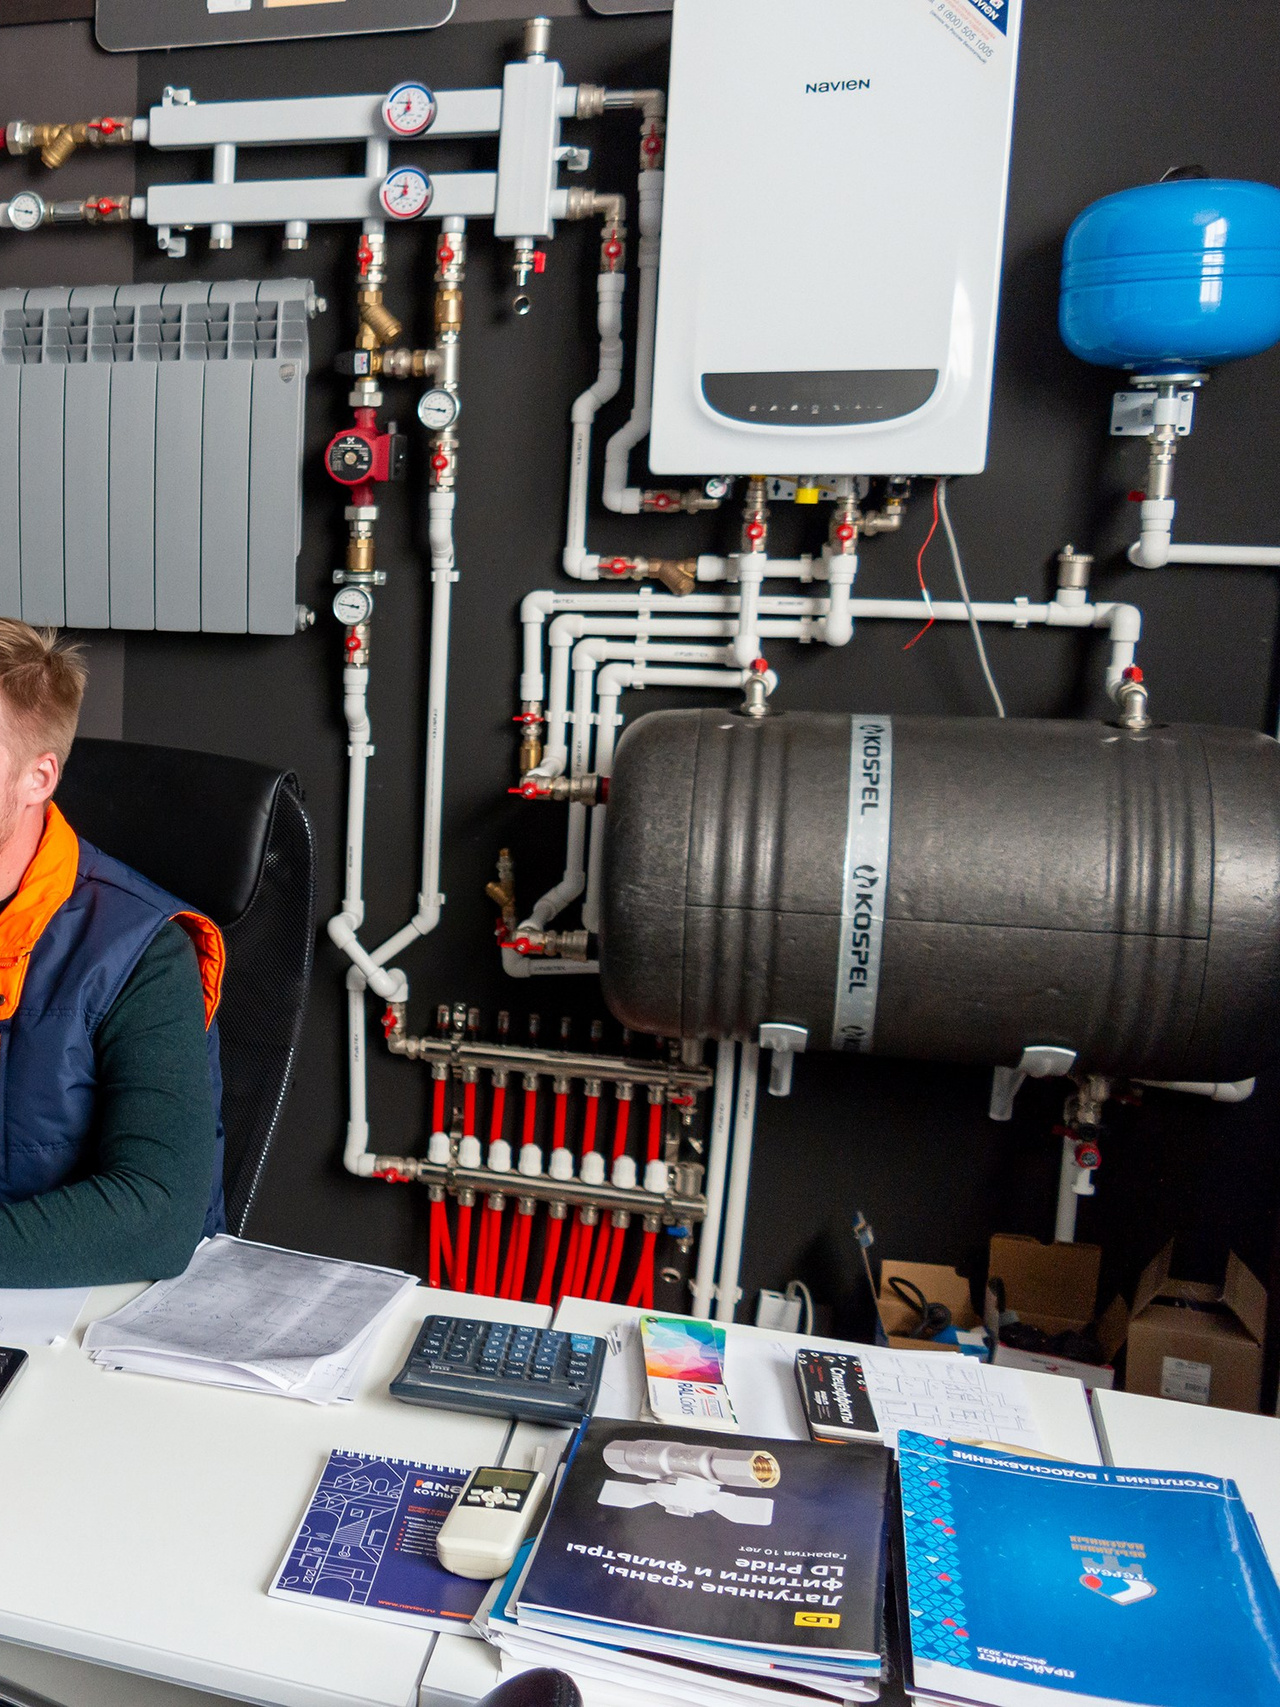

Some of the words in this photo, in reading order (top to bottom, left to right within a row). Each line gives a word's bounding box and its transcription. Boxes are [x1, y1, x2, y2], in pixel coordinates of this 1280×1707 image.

[942, 9, 963, 29] (800)
[961, 26, 977, 41] 505
[975, 39, 994, 58] 1005
[861, 735, 882, 815] KOSPEL
[849, 893, 873, 994] KOSPEL
[678, 1382, 695, 1396] RAL
[830, 1367, 854, 1424] Спецэффекты
[680, 1396, 698, 1416] Colors
[952, 1450, 1097, 1481] ВОДОСНАБЖЕНИЕ
[1116, 1475, 1220, 1490] ОТОПЛЕНИЕ
[413, 1487, 454, 1499] КОТЛЫ
[566, 1542, 687, 1575] фильтры
[784, 1550, 847, 1560] Гарантия
[602, 1562, 694, 1590] краны,
[694, 1566, 712, 1577] и
[735, 1558, 801, 1576] Pride
[811, 1565, 844, 1576] LD
[720, 1570, 843, 1591] фитинги
[701, 1582, 844, 1606] Латунные
[378, 1600, 436, 1614] www.navien.ru
[802, 1615, 834, 1624] LD
[977, 1653, 1076, 1679] ПРАЙС-ЛИСТ
